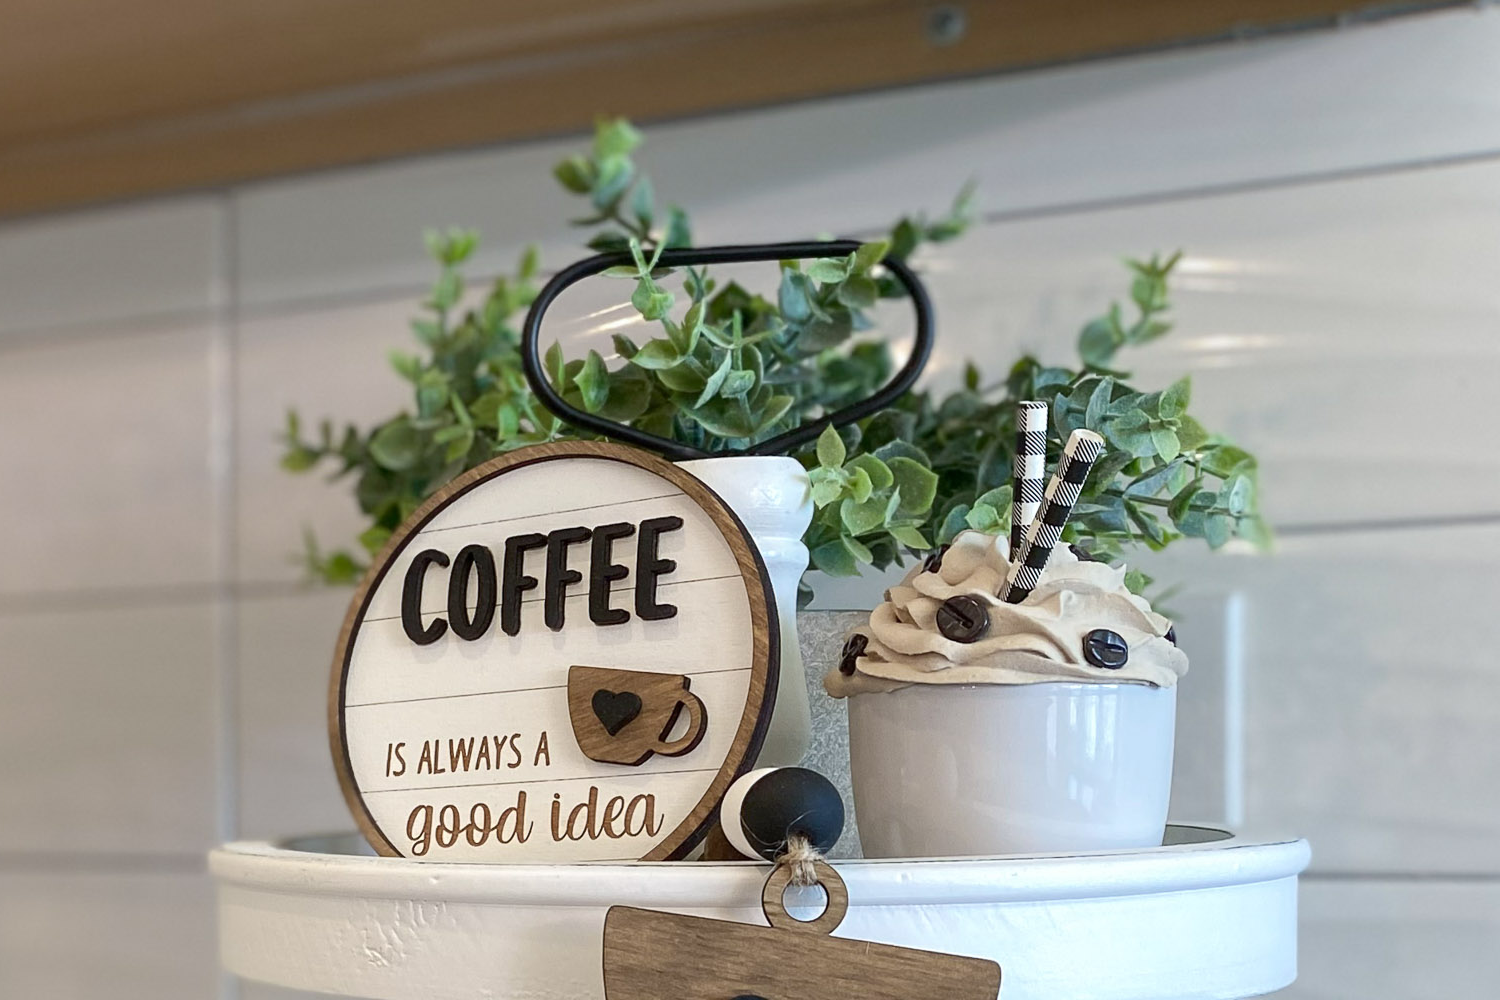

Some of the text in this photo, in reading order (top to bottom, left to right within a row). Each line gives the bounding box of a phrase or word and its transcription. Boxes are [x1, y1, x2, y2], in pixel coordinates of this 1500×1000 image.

[402, 516, 684, 646] COFFEE
[386, 731, 551, 777] IS ALWAYS A
[406, 786, 665, 857] good idea
